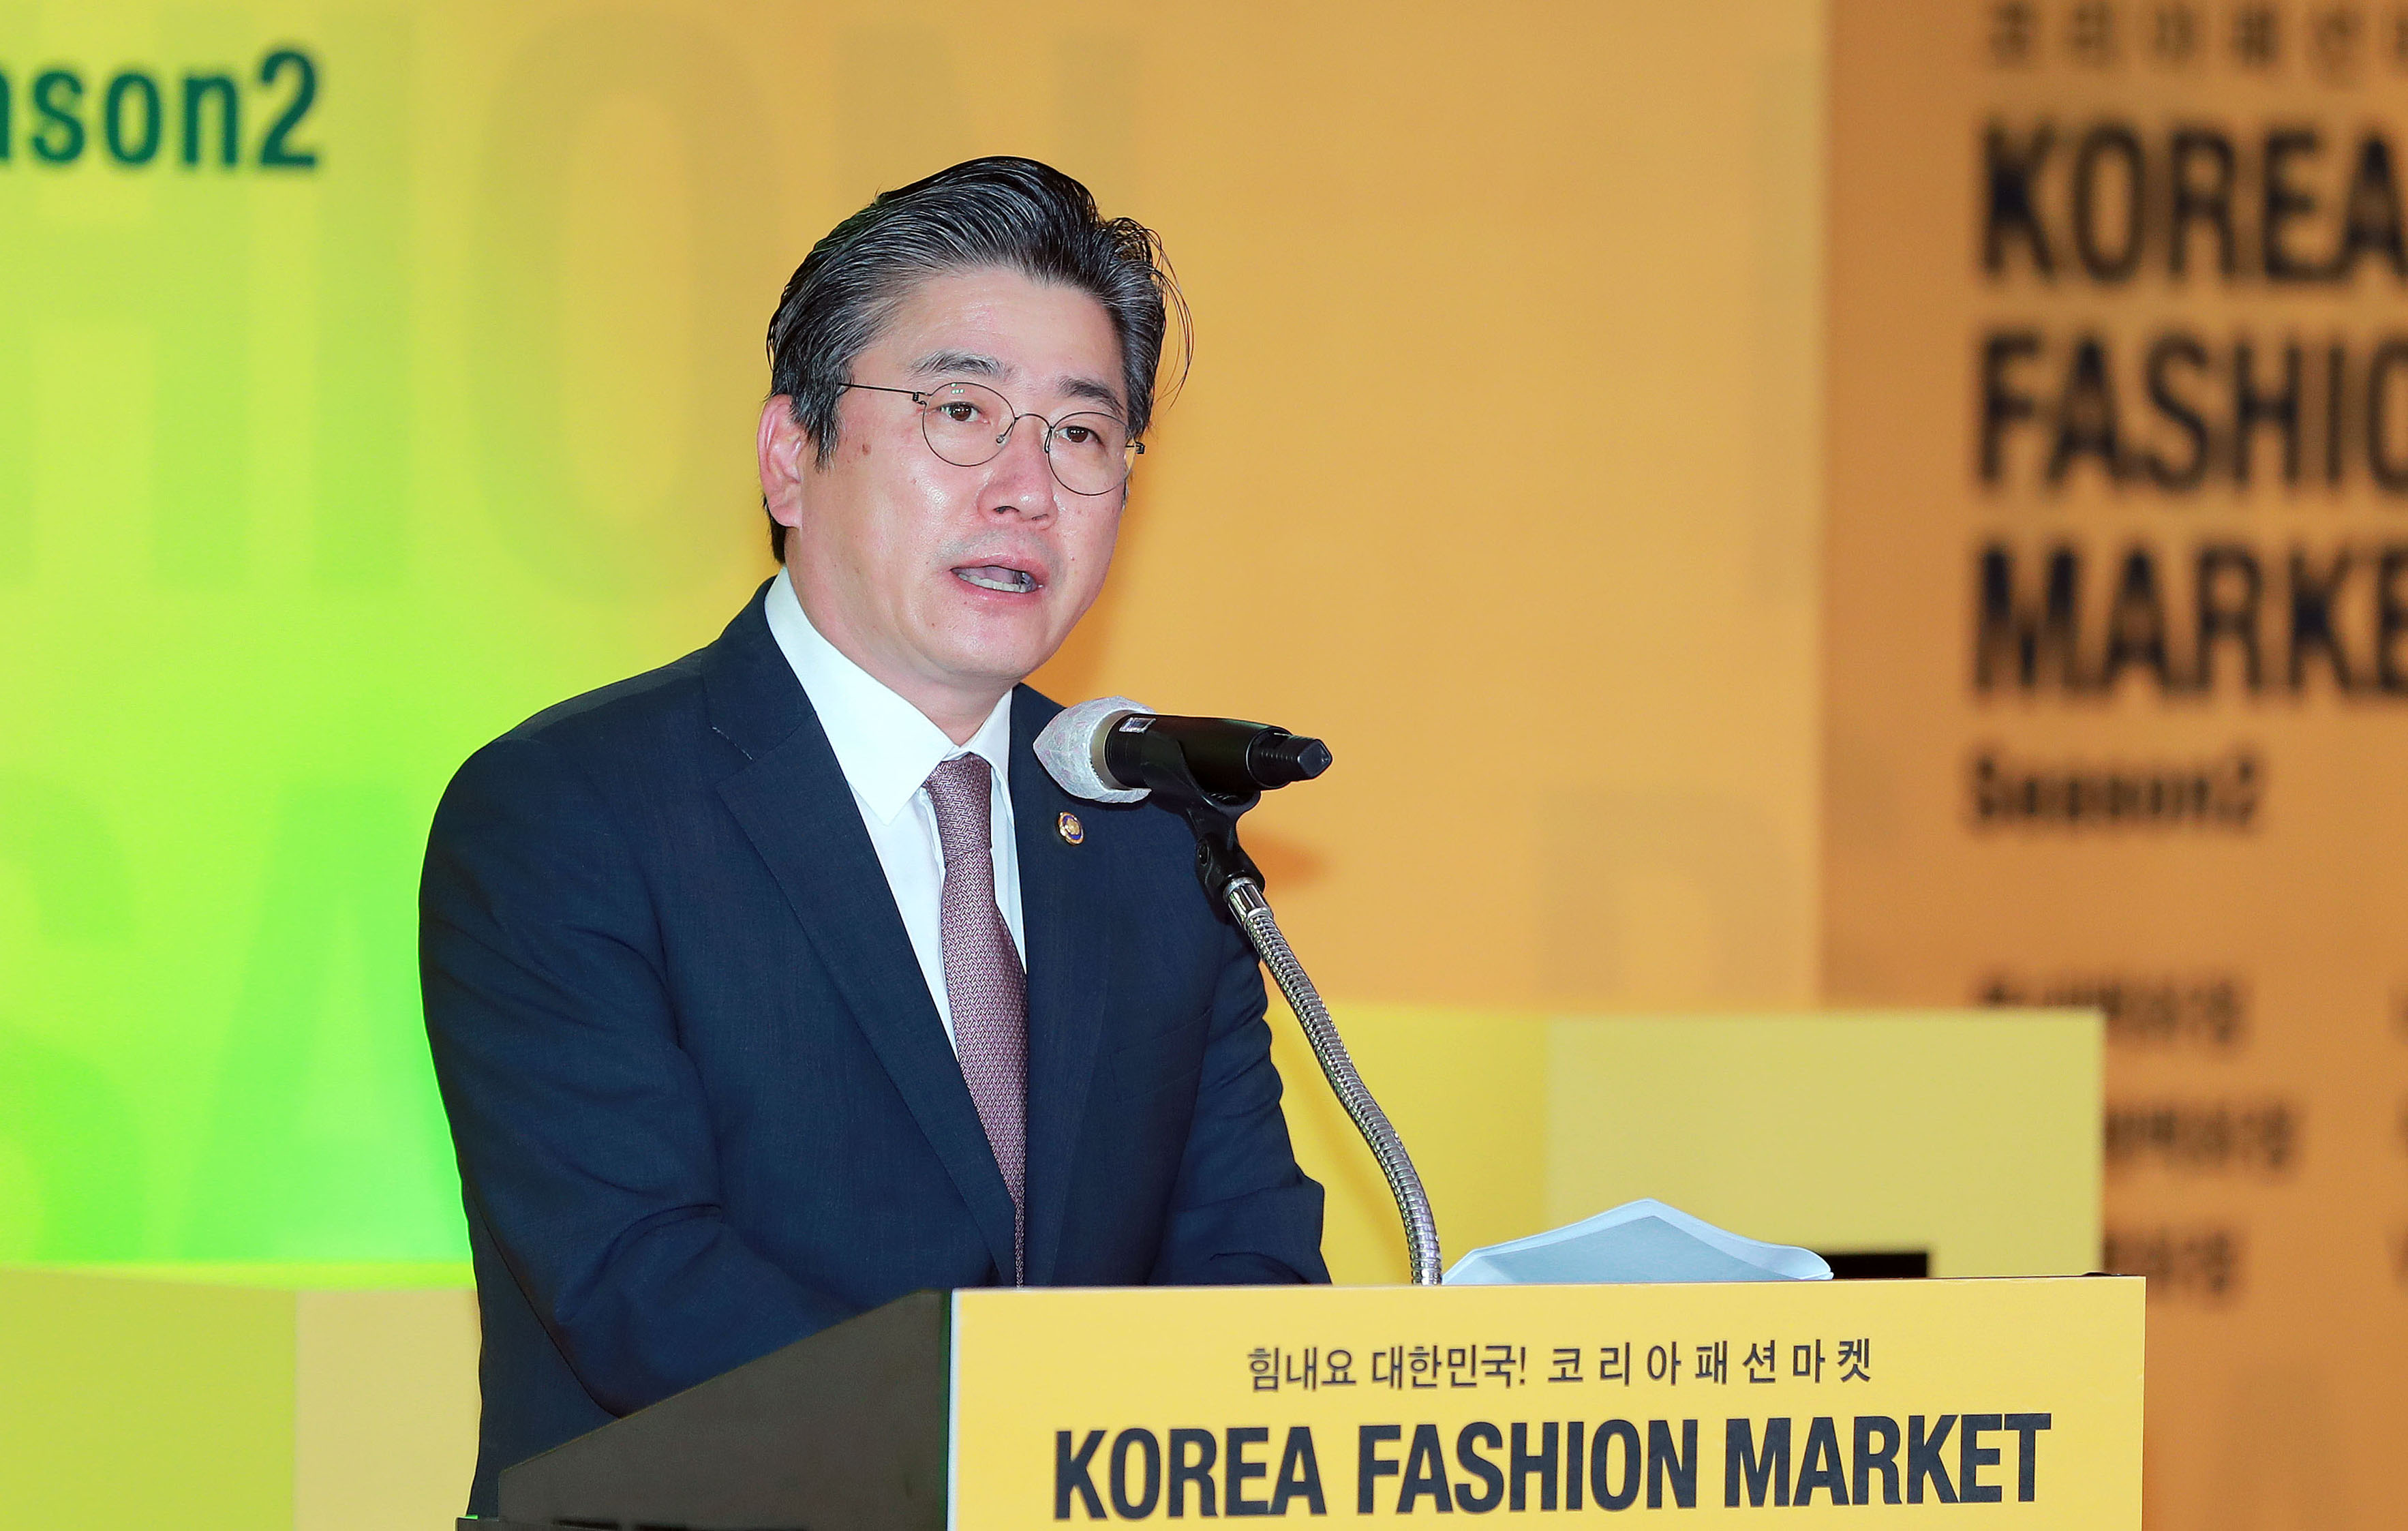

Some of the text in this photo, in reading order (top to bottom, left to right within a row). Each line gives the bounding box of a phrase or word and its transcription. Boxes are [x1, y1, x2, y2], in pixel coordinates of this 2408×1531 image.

[0, 48, 319, 169] son2
[1979, 119, 2408, 288] KOREA
[1248, 1346, 1357, 1391] 힘내요
[1372, 1344, 1527, 1390] 대한민국!
[1054, 1412, 2052, 1521] KOREA FASHION MARKET
